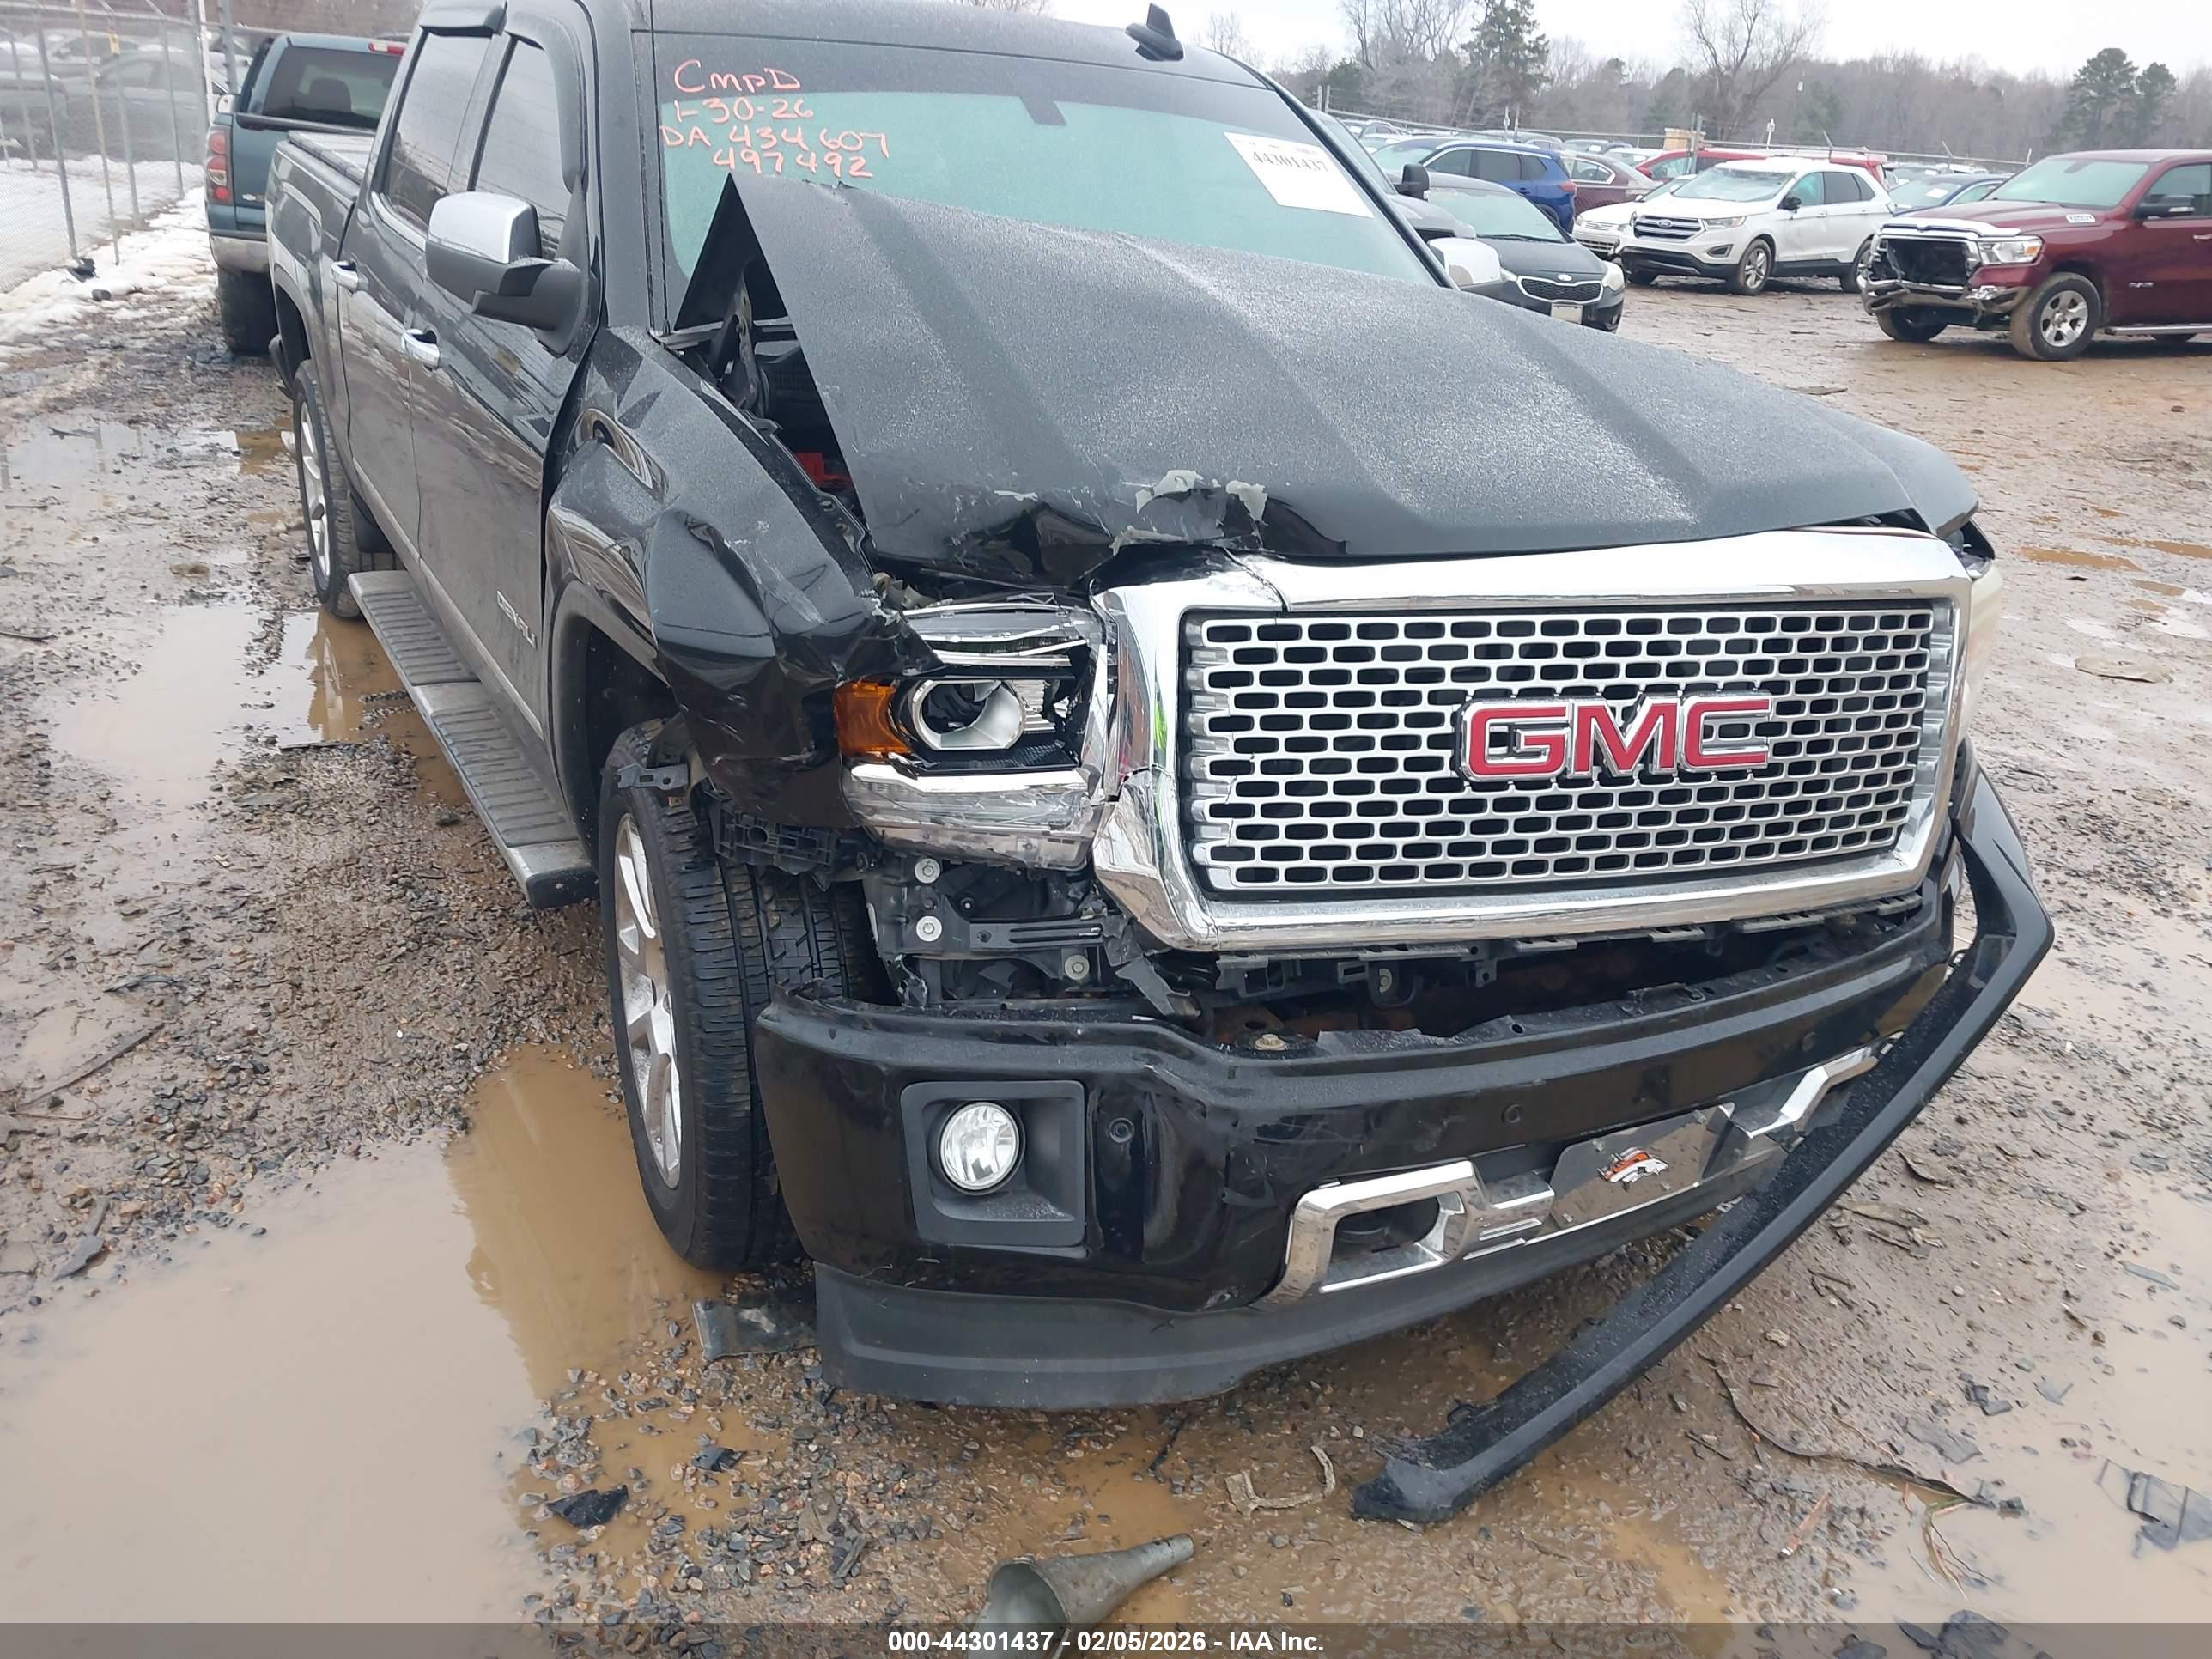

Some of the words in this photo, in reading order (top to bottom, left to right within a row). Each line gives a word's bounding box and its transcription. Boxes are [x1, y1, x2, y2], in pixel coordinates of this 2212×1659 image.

[674, 97, 814, 123] 1-30-26
[659, 125, 711, 148] DA
[1253, 151, 1328, 172] 44301437
[1460, 690, 1771, 781] GMC
